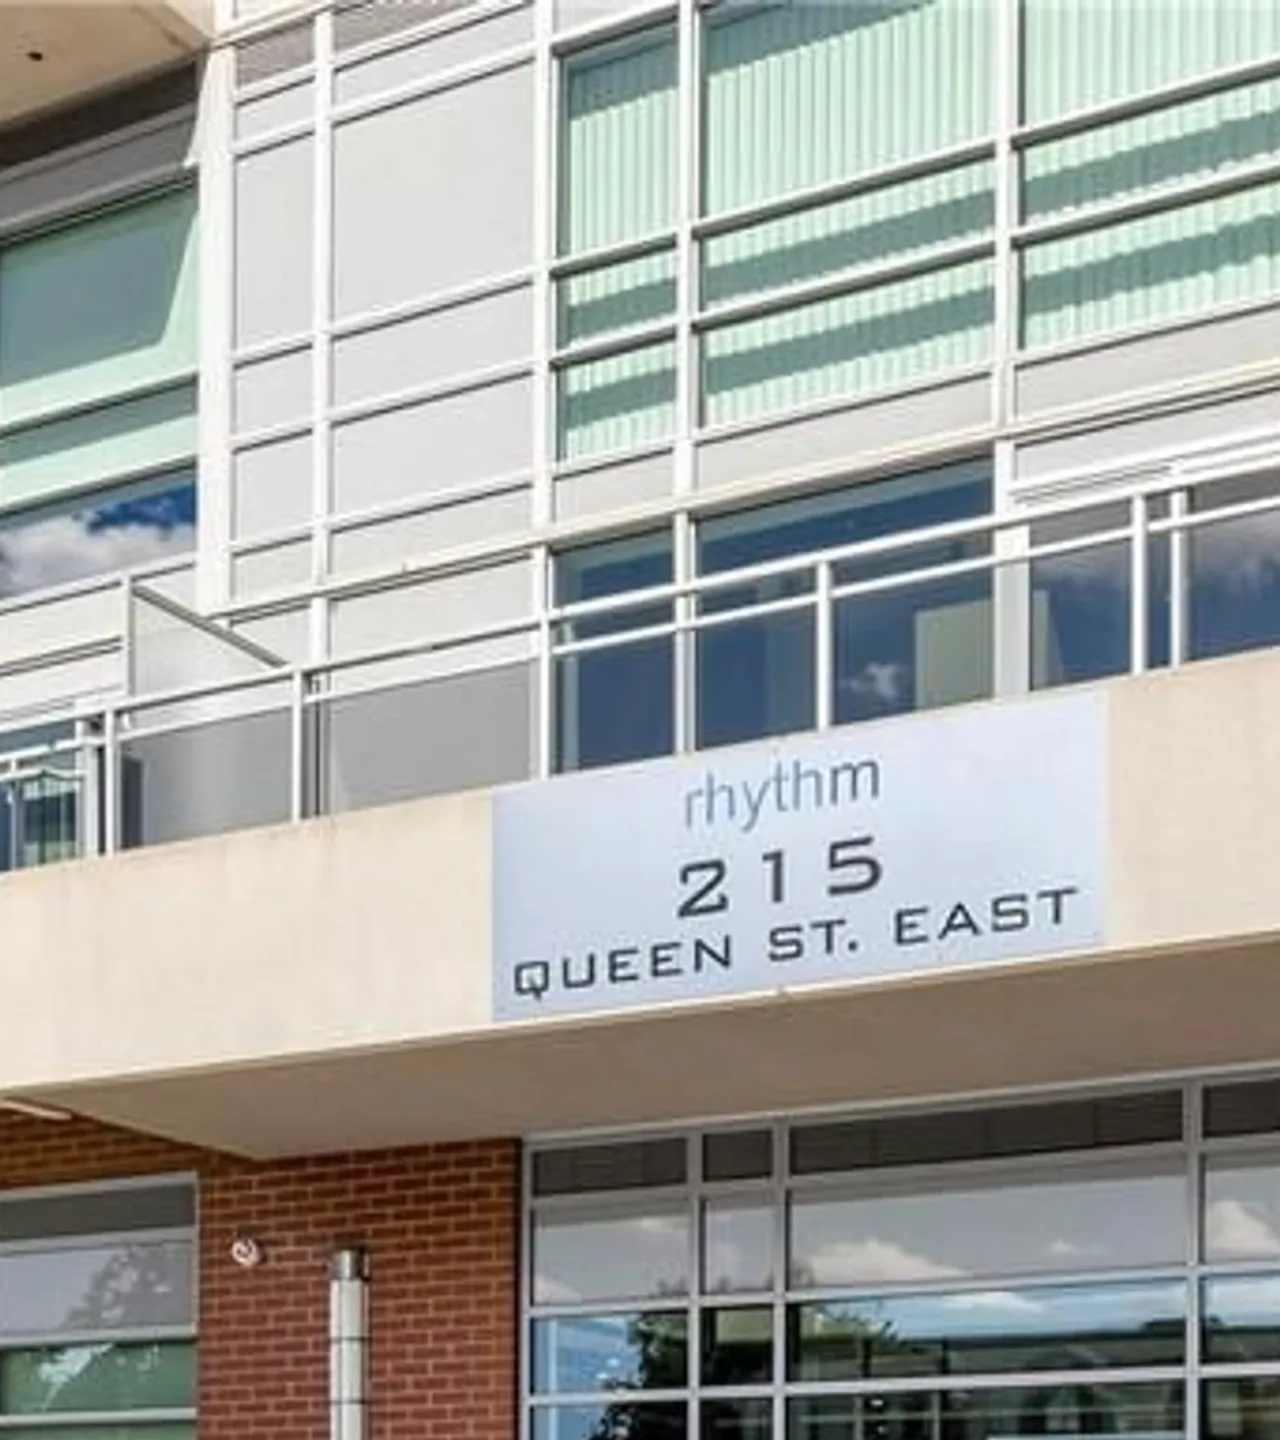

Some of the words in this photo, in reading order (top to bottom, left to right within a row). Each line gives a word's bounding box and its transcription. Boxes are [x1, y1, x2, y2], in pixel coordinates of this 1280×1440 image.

[683, 757, 882, 833] rhythm
[676, 835, 884, 918] 215
[514, 934, 733, 1000] QUEEN
[768, 918, 859, 963] ST.
[893, 886, 1081, 946] EAST
